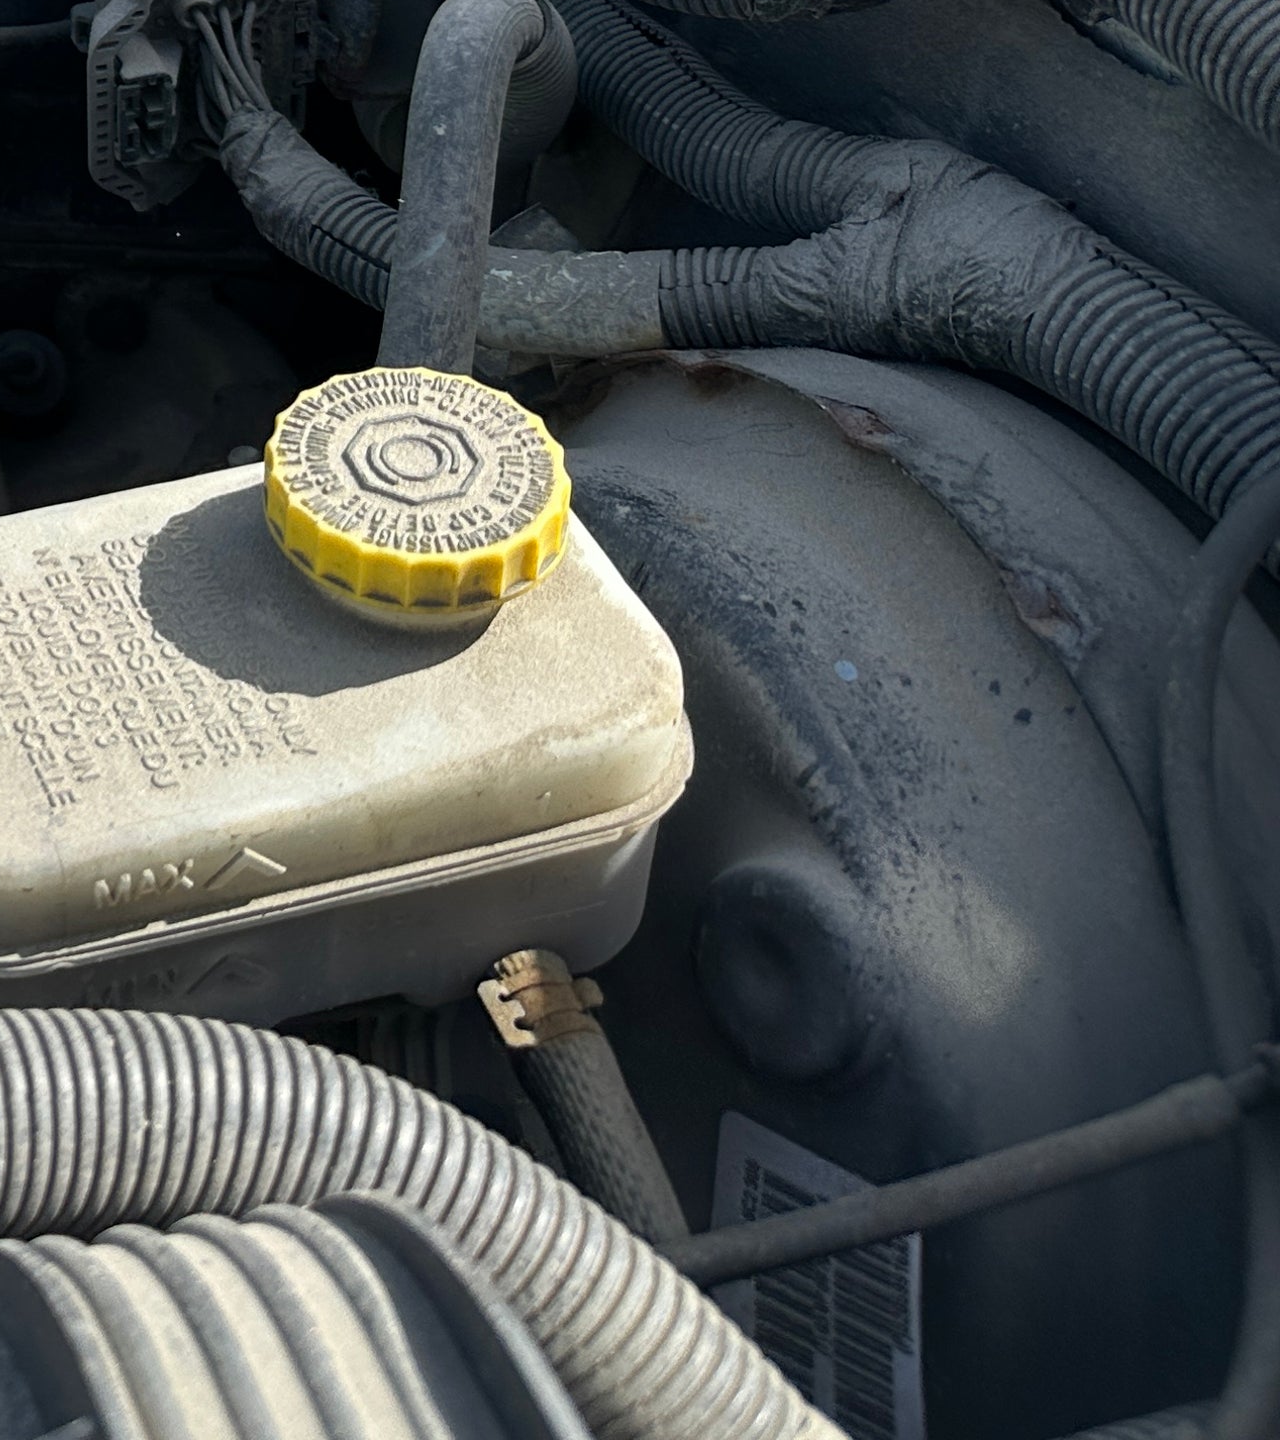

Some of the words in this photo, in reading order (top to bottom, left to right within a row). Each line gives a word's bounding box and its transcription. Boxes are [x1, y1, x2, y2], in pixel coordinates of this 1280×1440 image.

[489, 444, 525, 506] FILLER
[362, 521, 509, 554] REMPLISSAGE
[19, 590, 83, 682] LIQUIDE
[113, 699, 159, 752] QUE
[141, 751, 181, 794] DU
[93, 855, 195, 909] MAX
